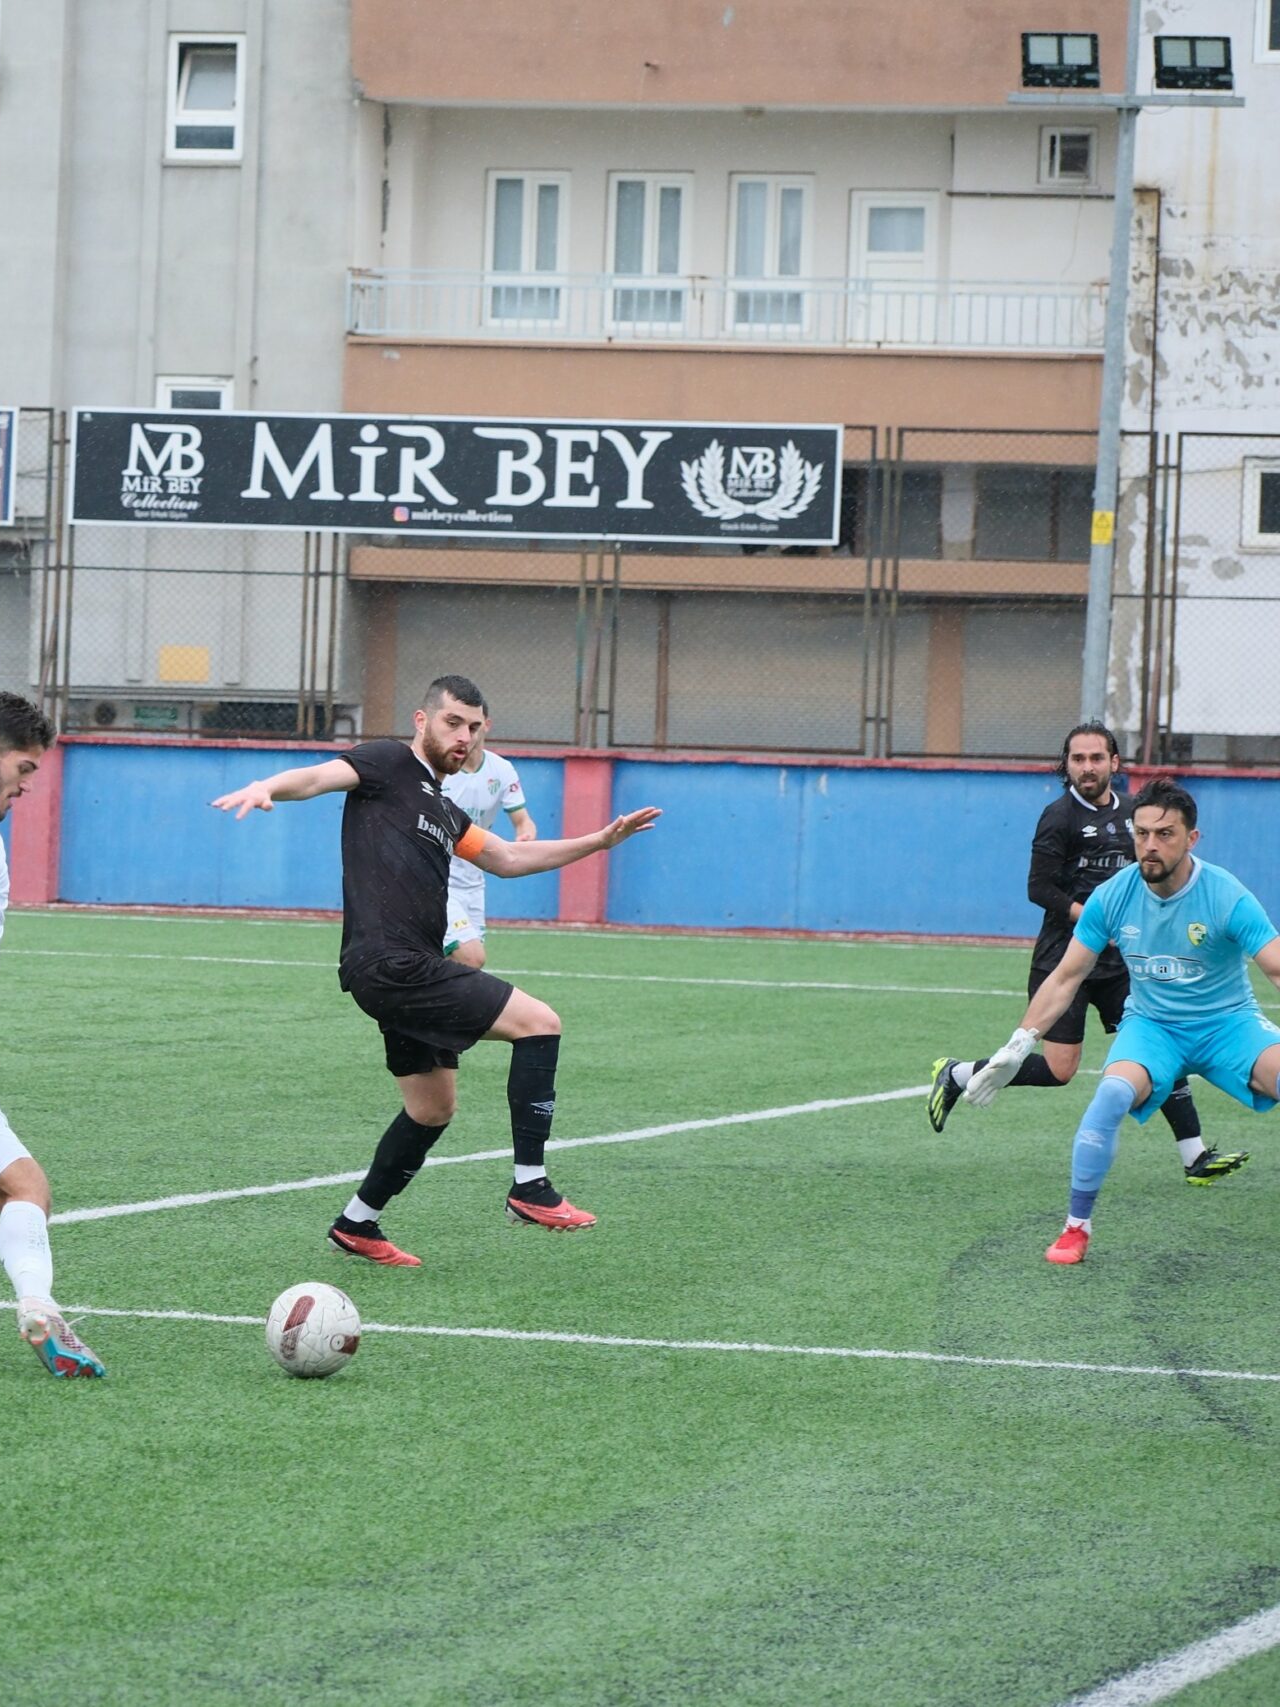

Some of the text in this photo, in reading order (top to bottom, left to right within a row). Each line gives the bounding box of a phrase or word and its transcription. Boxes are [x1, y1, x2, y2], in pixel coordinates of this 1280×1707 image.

[121, 422, 206, 478] MB
[472, 426, 673, 509] BEY
[726, 446, 777, 480] MB
[164, 477, 204, 494] BEY
